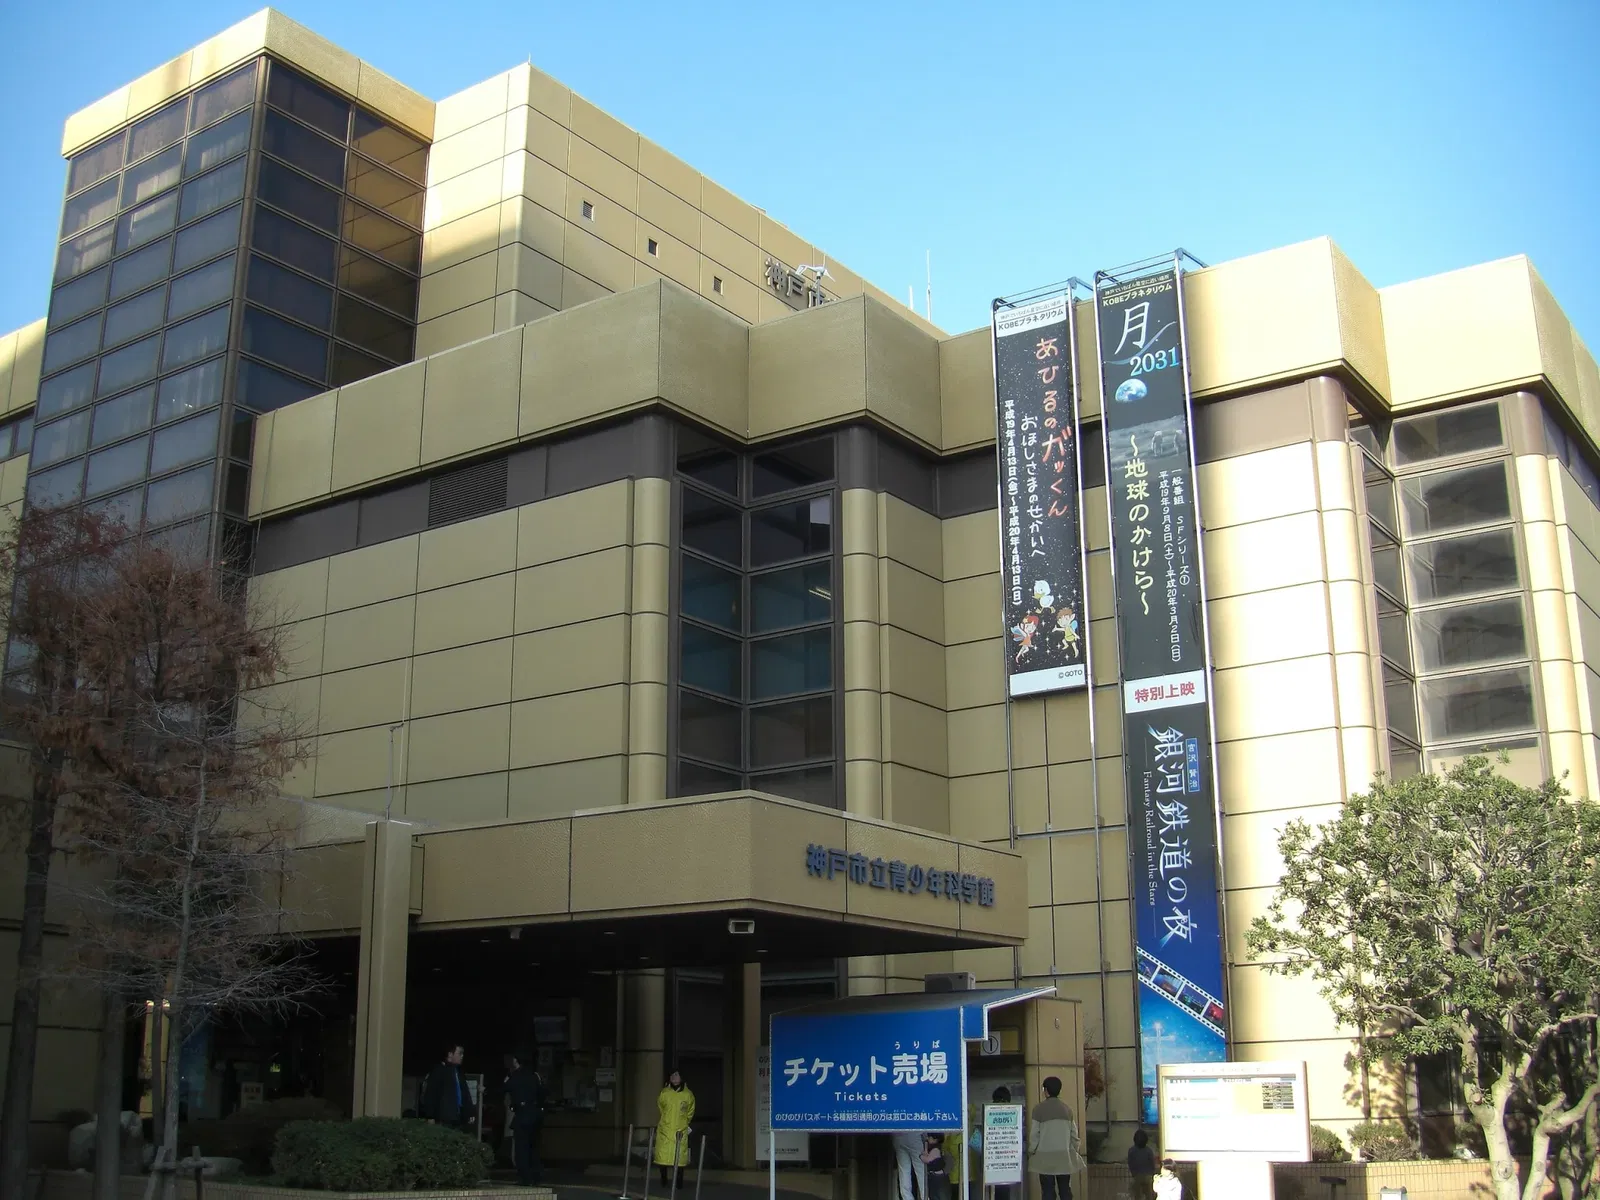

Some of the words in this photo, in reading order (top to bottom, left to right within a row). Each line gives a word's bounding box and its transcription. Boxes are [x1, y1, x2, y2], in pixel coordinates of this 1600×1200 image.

[1102, 284, 1173, 307] KOBEプラネタリウム
[998, 309, 1064, 330] KOBEプラネタリウム
[1114, 301, 1149, 355] 月
[1129, 346, 1180, 377] 2031
[1035, 337, 1072, 518] あひるのガッくん
[1020, 415, 1046, 558] おほしさまのせかいへ
[1171, 468, 1185, 506] 一般番組
[1134, 681, 1196, 704] 特別上映
[1143, 770, 1152, 808] Fantasy
[1145, 809, 1157, 850] Railroad
[1147, 723, 1198, 950] 銀河鉄道の夜
[1147, 851, 1156, 863] in
[1148, 863, 1158, 880] the
[806, 843, 995, 908] 神戸市立青少年科学館
[1149, 881, 1159, 906] Stars
[894, 1040, 940, 1050] うりば
[783, 1052, 948, 1086] チケット売場
[834, 1091, 888, 1101] Tickets
